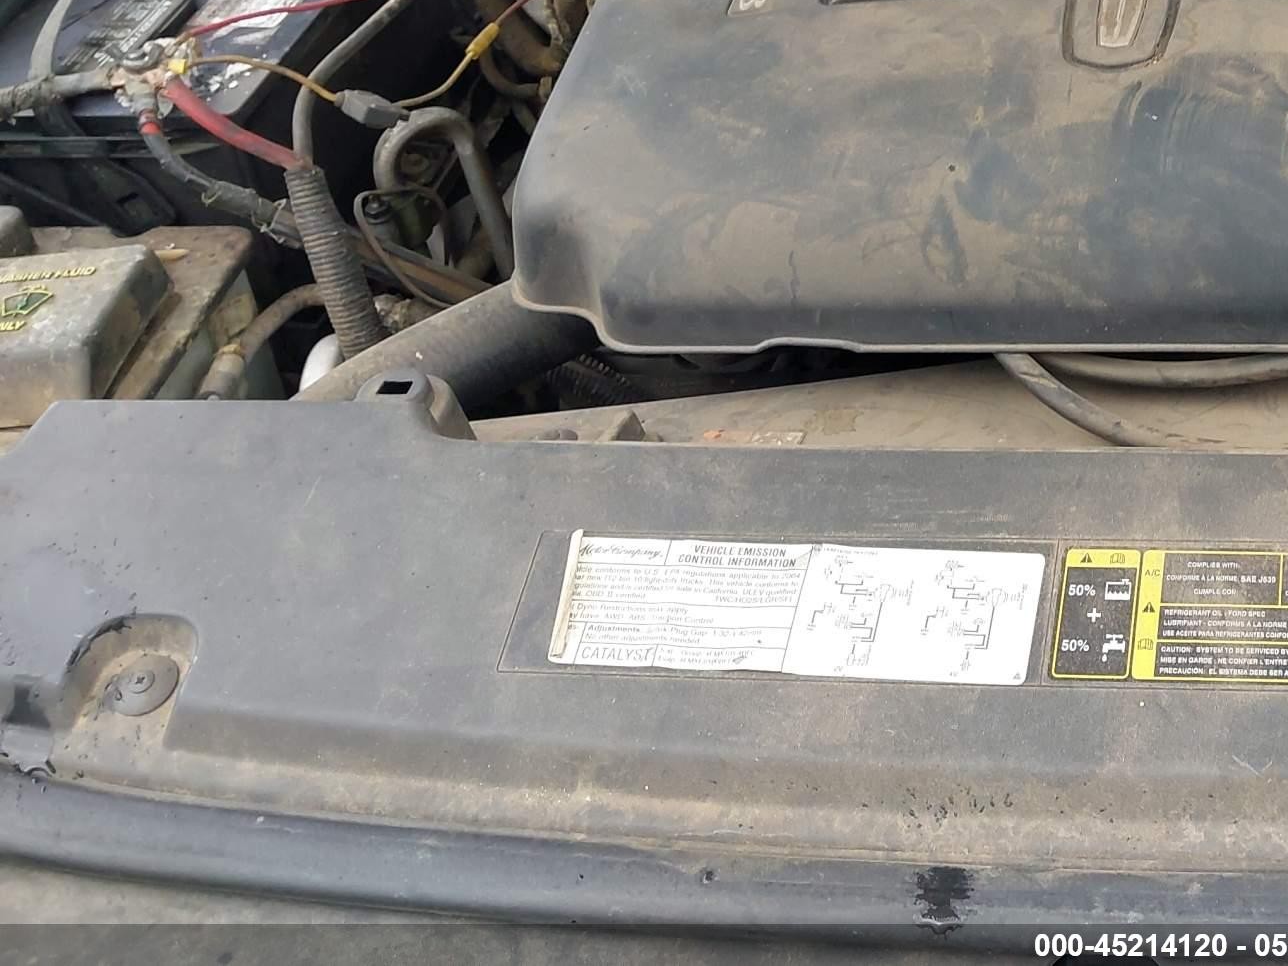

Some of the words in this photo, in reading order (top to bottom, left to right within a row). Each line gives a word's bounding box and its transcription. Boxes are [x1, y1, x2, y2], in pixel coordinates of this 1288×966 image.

[55, 266, 96, 279] FLUID
[695, 545, 736, 555] VEHICLE
[738, 547, 786, 557] EMISSION
[678, 554, 724, 566] CONTROL
[728, 557, 796, 568] INFORMATION
[1240, 575, 1257, 583] SAE
[1068, 584, 1096, 596] 50%
[1061, 639, 1090, 651] 50%
[581, 646, 655, 662] CATALYST
[1160, 656, 1176, 664] MISE
[1178, 656, 1187, 664] EN
